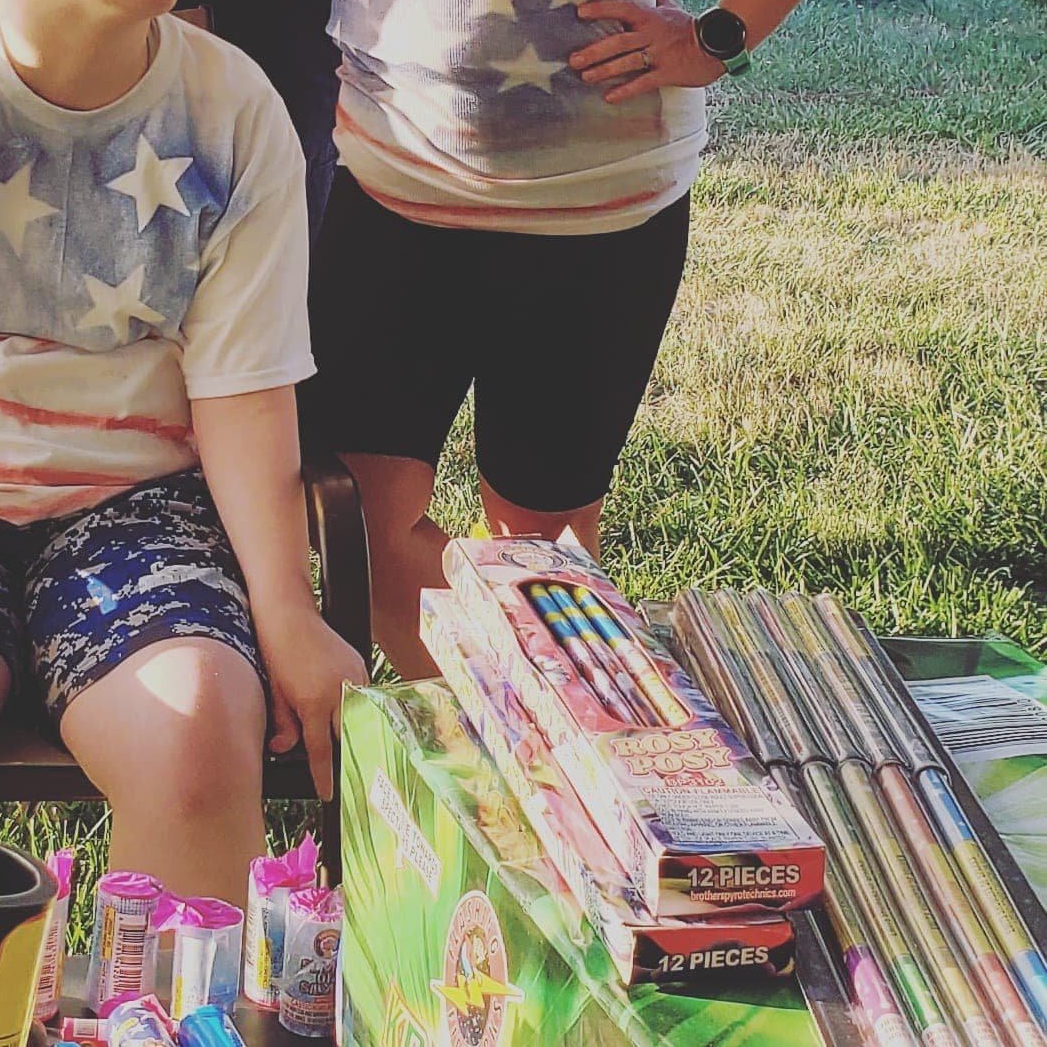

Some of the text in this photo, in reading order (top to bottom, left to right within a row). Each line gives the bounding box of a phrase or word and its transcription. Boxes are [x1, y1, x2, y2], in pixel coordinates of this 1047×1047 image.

[612, 729, 720, 756] ROSY
[627, 747, 731, 776] POSY
[687, 864, 800, 887] 12 PIECES
[690, 888, 796, 902] brotherspyrotechnics.com
[658, 946, 769, 972] 12 PIECES
